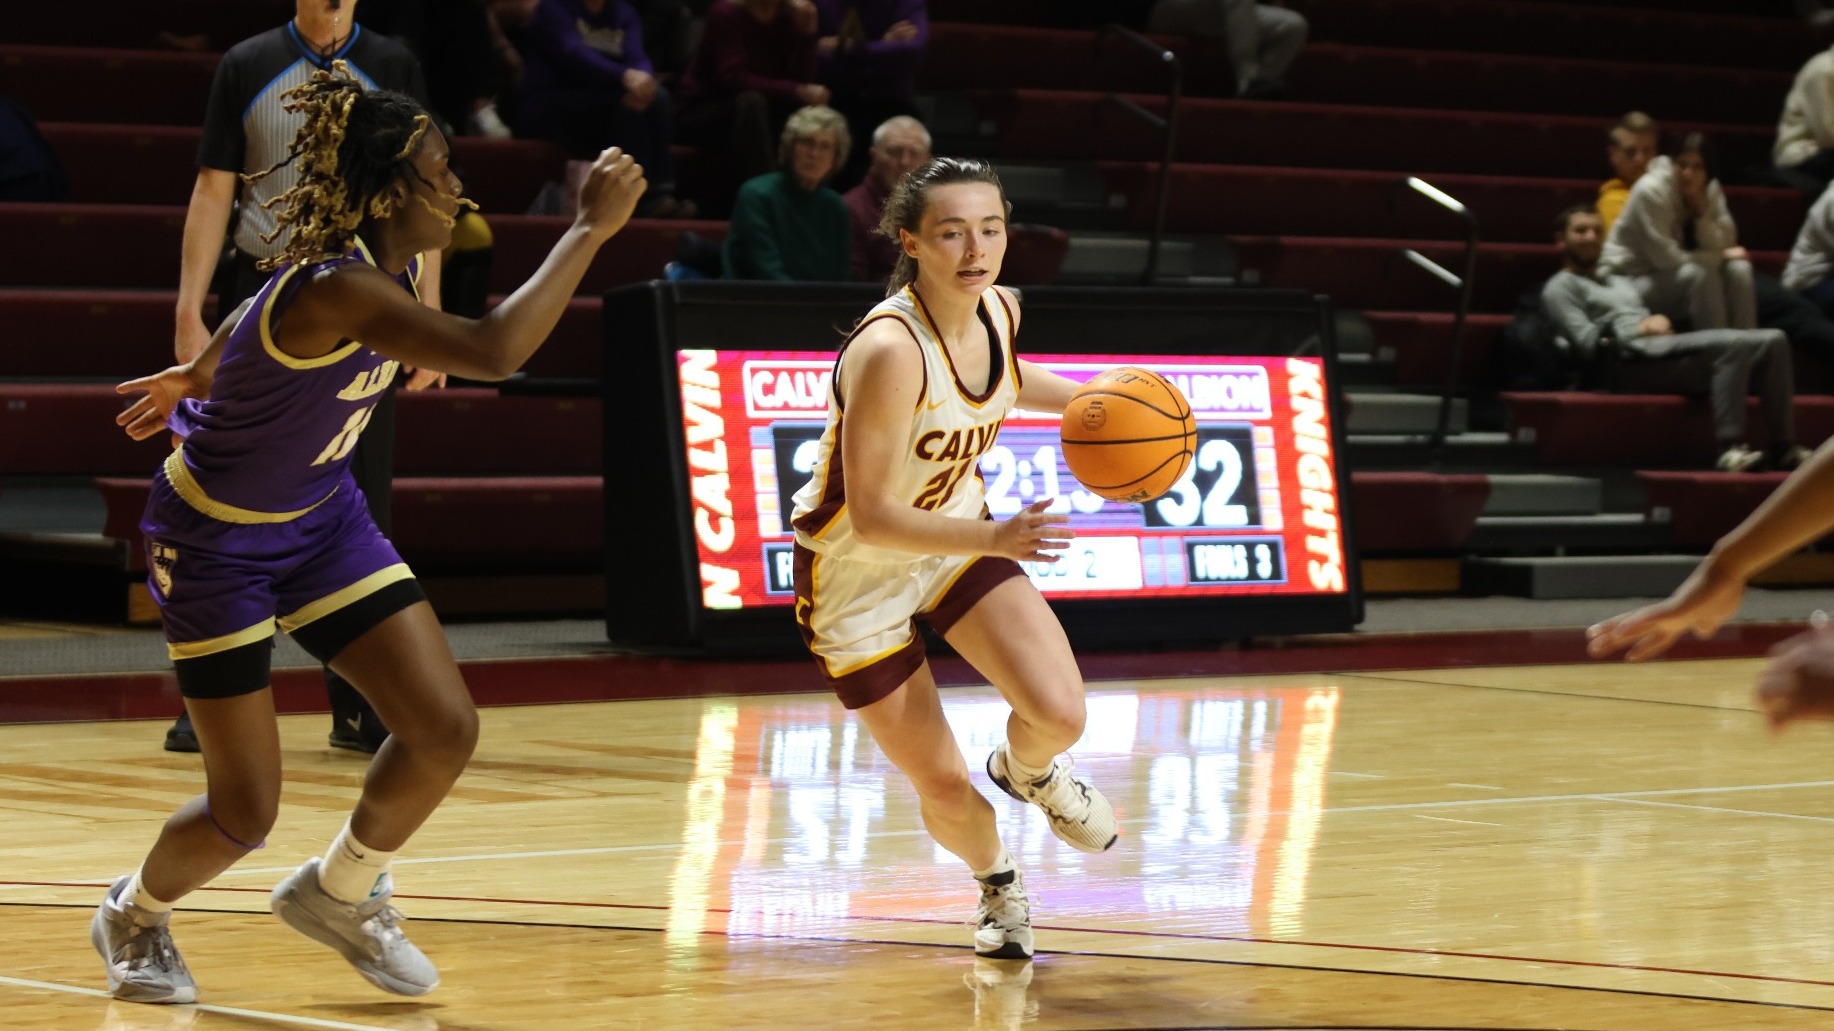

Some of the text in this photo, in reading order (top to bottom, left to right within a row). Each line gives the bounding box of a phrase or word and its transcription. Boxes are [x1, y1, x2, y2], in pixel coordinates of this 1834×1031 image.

[336, 360, 400, 401] ALBI
[752, 370, 832, 408] CALV
[680, 349, 735, 554] CALVIN
[915, 419, 1002, 462] CALVI
[1157, 439, 1248, 526] 32
[1287, 357, 1343, 592] KNIGHTS
[1083, 549, 1098, 579] 2
